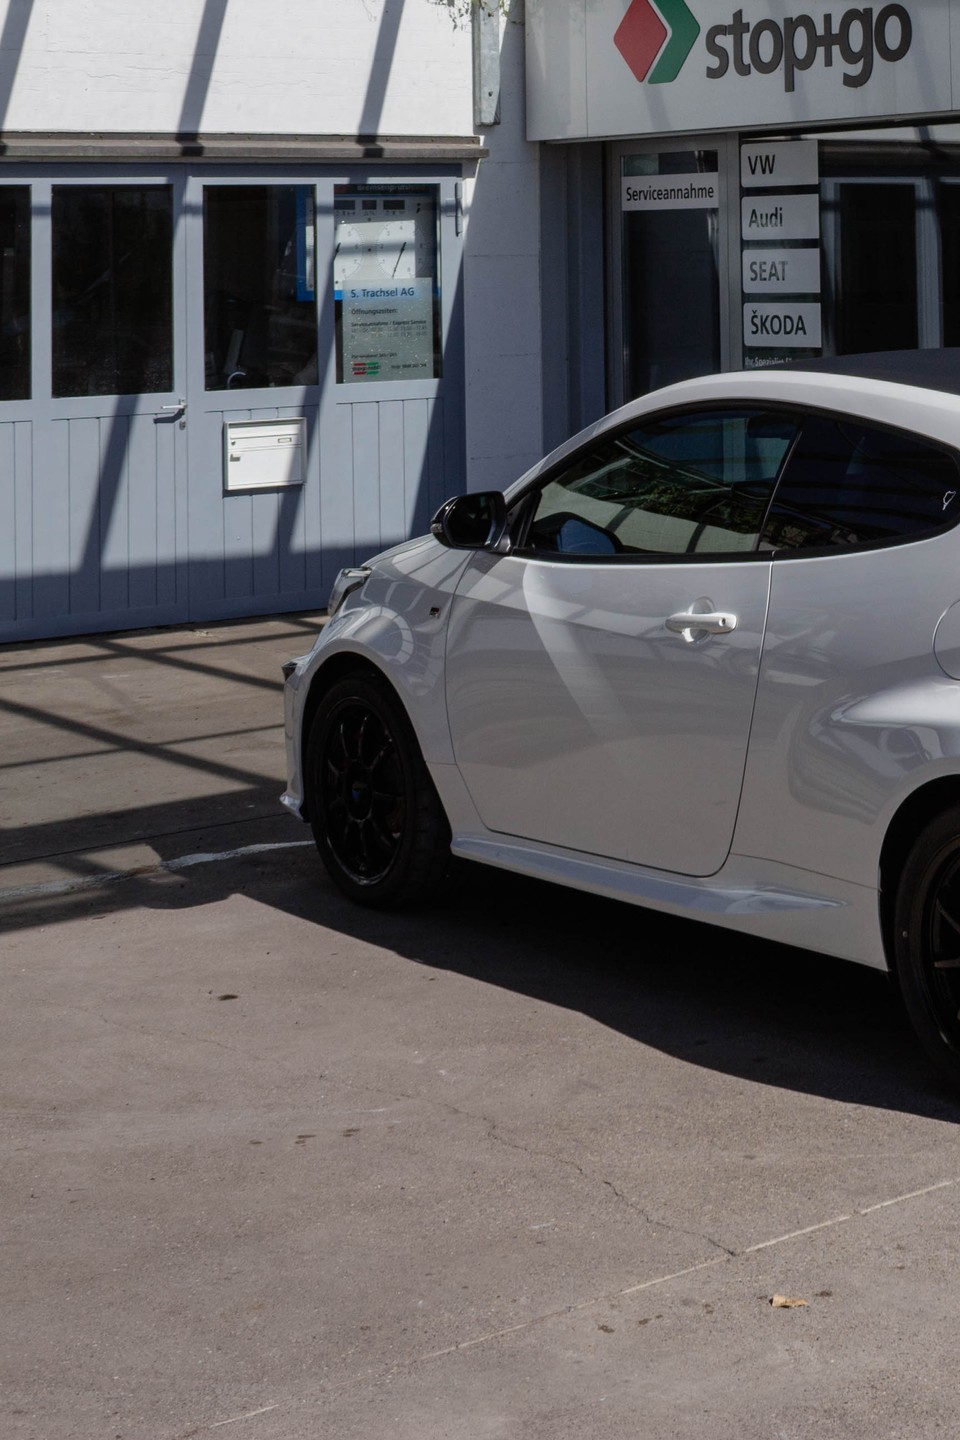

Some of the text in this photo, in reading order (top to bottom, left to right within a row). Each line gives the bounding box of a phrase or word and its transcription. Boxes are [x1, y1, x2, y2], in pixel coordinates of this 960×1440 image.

[704, 3, 912, 93] stop+go
[747, 154, 776, 175] VW
[626, 183, 714, 202] Serviceannahme
[748, 207, 784, 228] Audi
[749, 260, 788, 282] SEAT
[351, 287, 415, 298] S. Trachsel AG
[751, 310, 807, 335] ŠKODA
